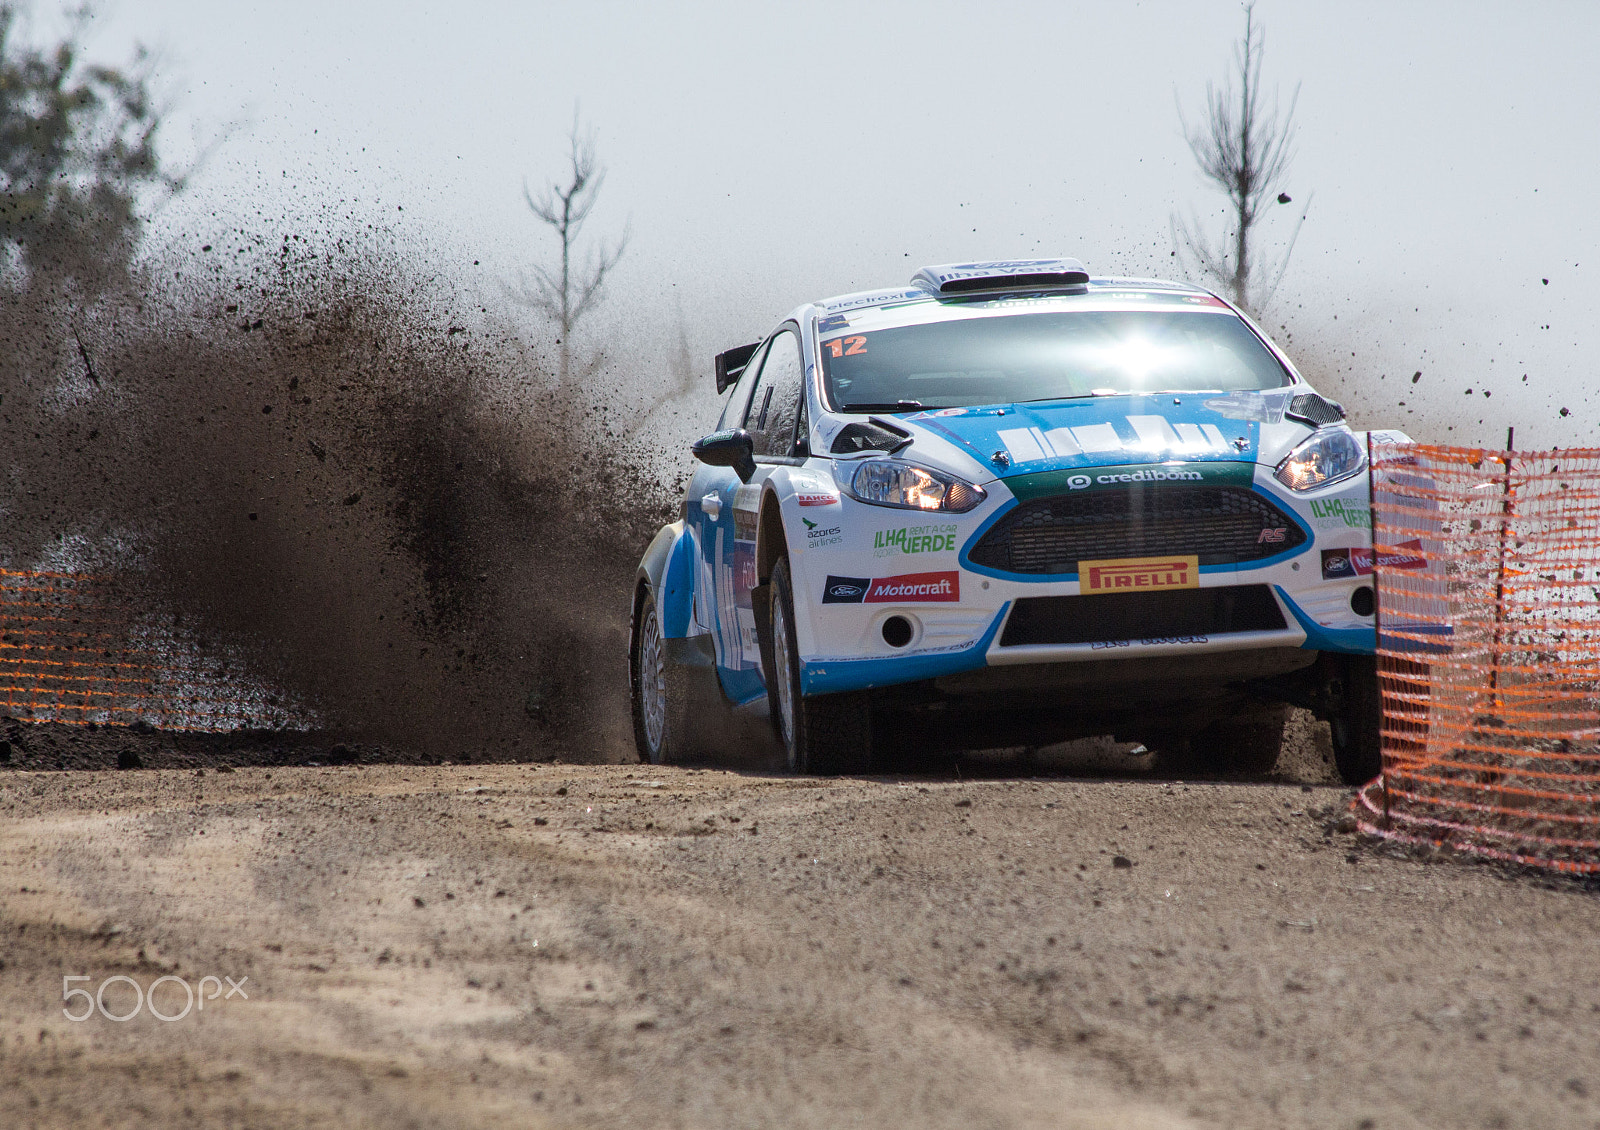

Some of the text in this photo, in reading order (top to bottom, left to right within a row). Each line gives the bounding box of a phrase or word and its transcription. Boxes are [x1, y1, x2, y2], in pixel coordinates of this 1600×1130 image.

[825, 336, 868, 358] 12
[1096, 469, 1204, 485] credibom
[1309, 498, 1345, 519] ILHA
[807, 526, 841, 539] azores
[873, 527, 908, 549] ILHA
[909, 525, 932, 536] RENT
[939, 524, 958, 533] CAR
[1258, 528, 1287, 543] RS
[808, 536, 843, 549] airlines
[1089, 562, 1188, 589] PIRELLI
[832, 579, 952, 597] Ford Motorcraft
